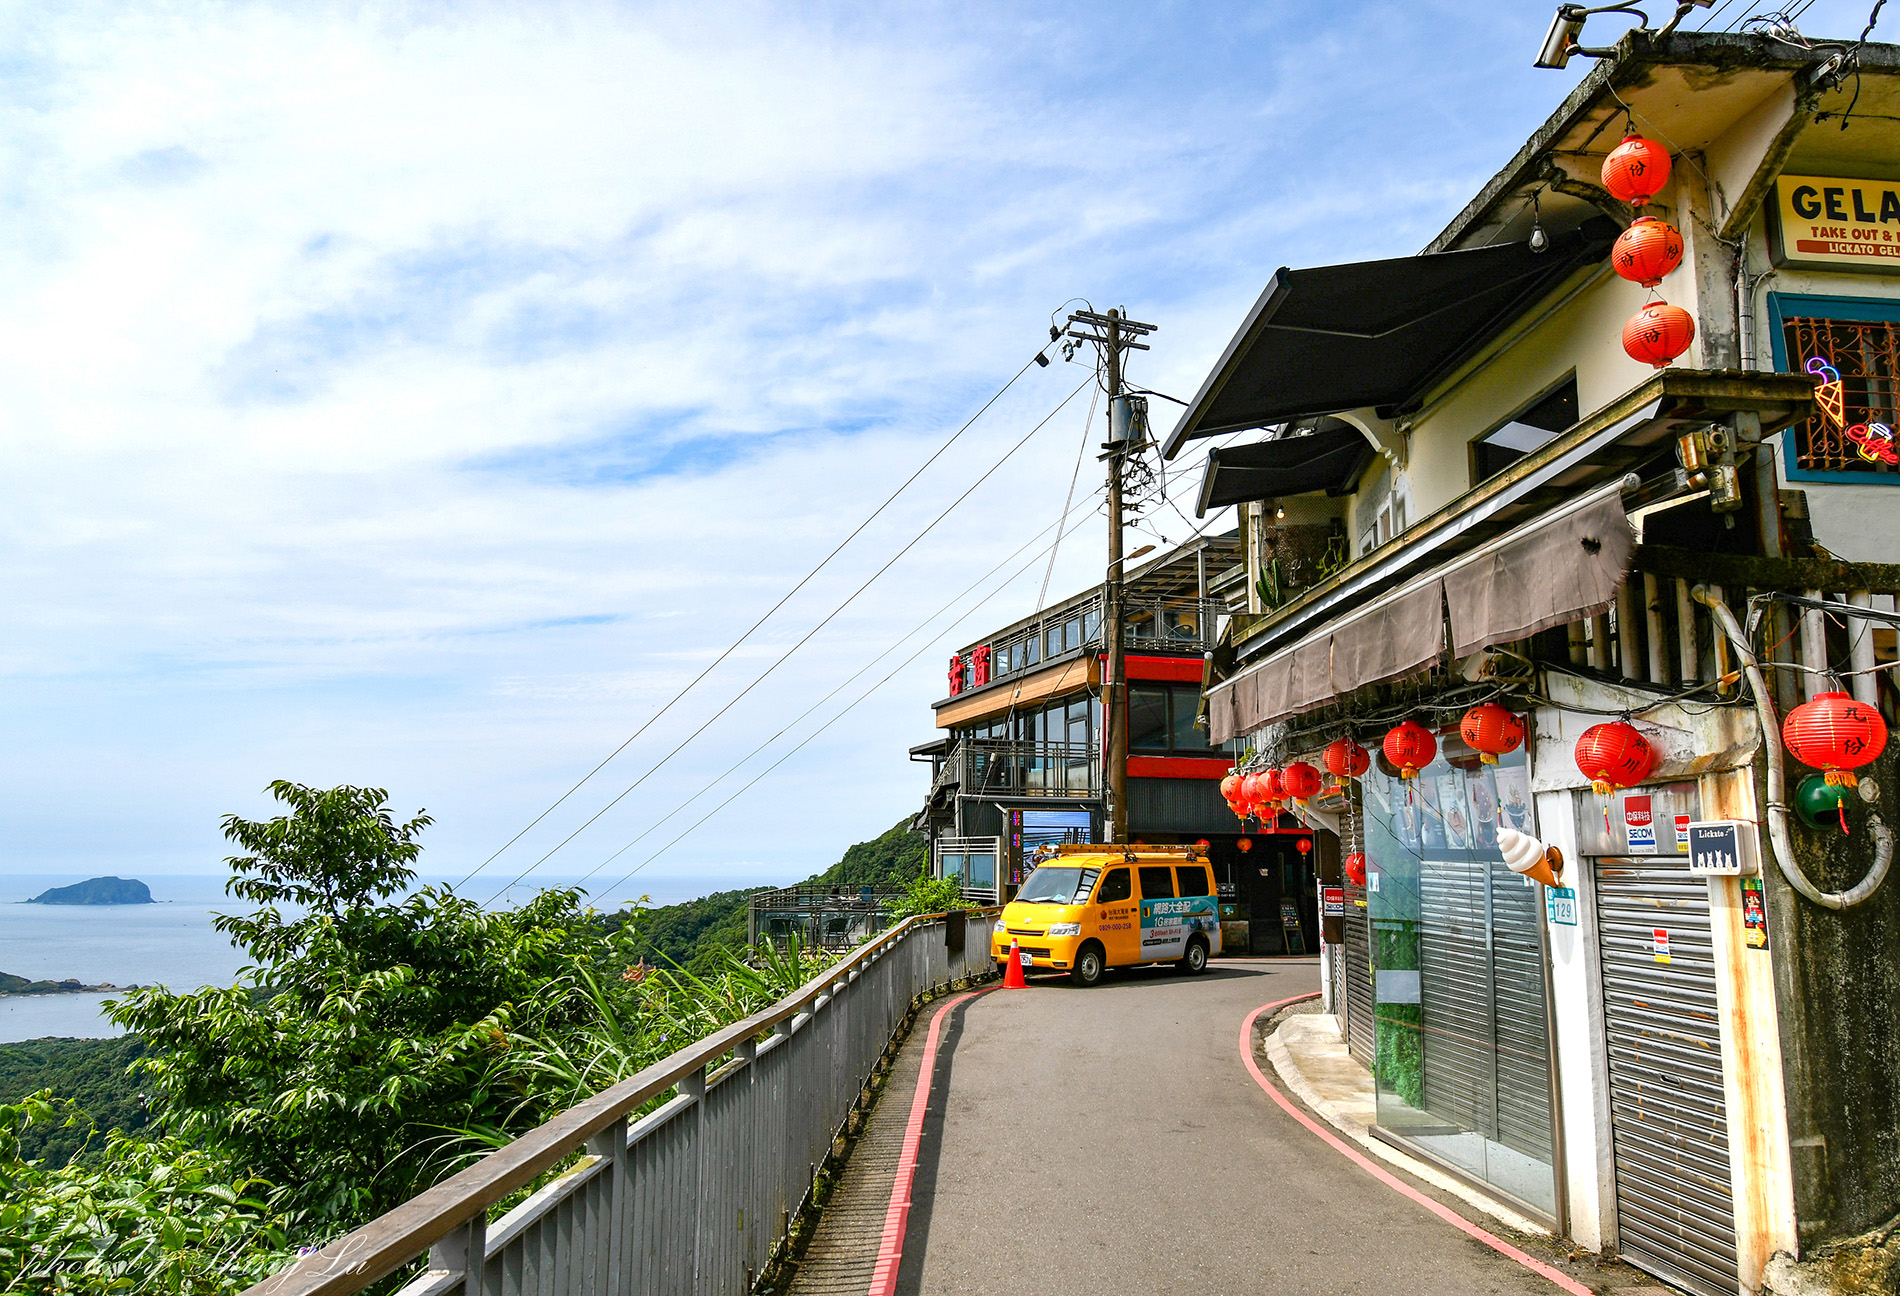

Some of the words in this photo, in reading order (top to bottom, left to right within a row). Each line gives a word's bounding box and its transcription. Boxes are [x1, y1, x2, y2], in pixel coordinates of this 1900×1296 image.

[1628, 141, 1646, 177] 九份
[1792, 185, 1900, 224] GELA
[1811, 226, 1847, 239] TAKE
[1851, 228, 1878, 241] OUT
[1882, 230, 1893, 242] &
[1829, 242, 1875, 255] LICKATO
[1879, 245, 1900, 257] GEL
[1641, 310, 1661, 343] 九份
[1843, 707, 1866, 755] 九份
[1626, 810, 1651, 821] 中保科技
[1629, 828, 1653, 838] SECOM
[1698, 830, 1725, 838] Lickato
[1153, 901, 1191, 915] 網路大全配
[1556, 903, 1571, 917] 129
